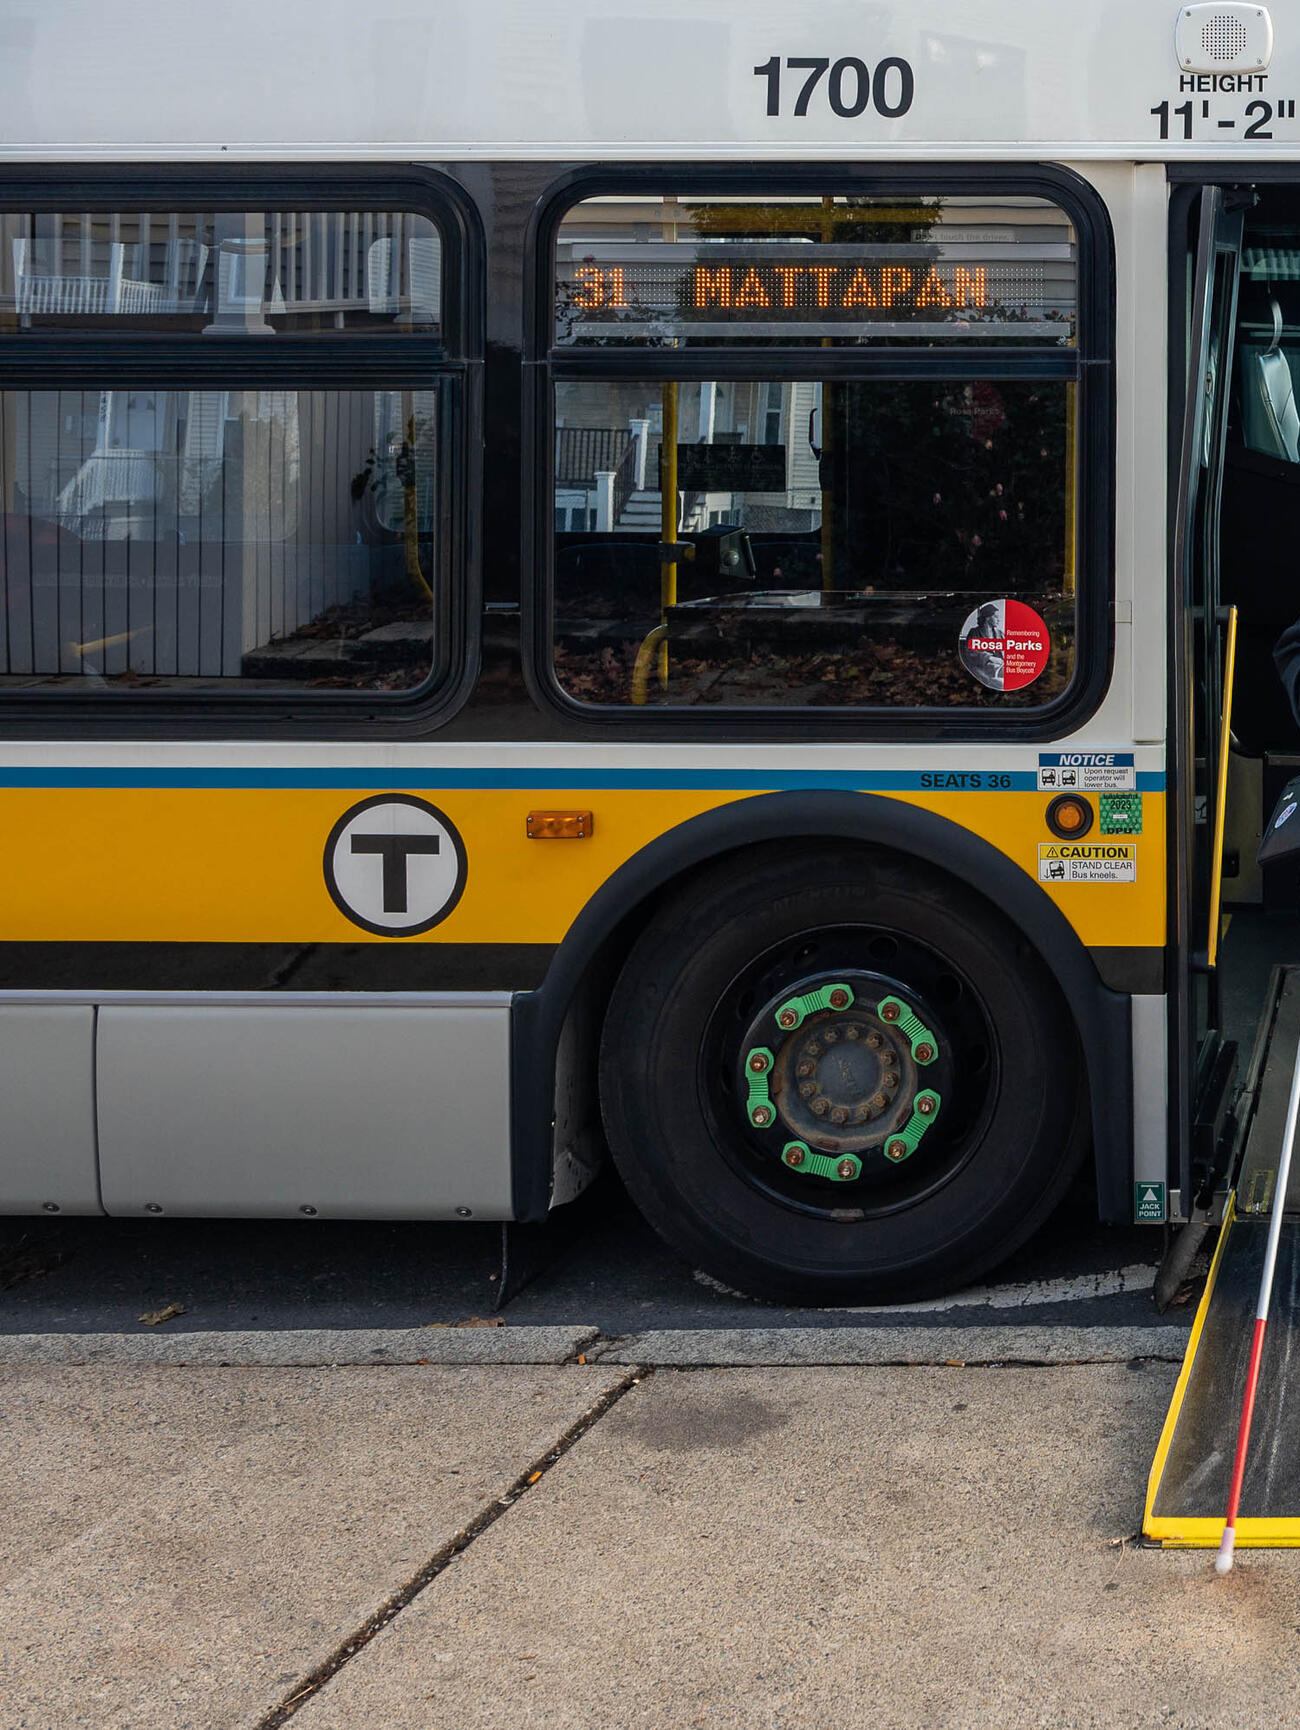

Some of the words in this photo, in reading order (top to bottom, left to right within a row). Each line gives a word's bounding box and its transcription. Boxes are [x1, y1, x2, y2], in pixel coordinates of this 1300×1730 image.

[754, 56, 914, 118] 1700
[1179, 74, 1269, 93] HEIGHT
[573, 267, 628, 308] 31
[695, 267, 986, 308] MATTAPAN
[1006, 629, 1040, 638] Remembering
[971, 639, 1003, 650] Rosa
[1006, 639, 1042, 651] Parks
[1059, 754, 1115, 766] NOTICE
[1084, 768, 1103, 776] Upon
[1103, 768, 1129, 776] request
[920, 773, 982, 788] SEATS
[987, 774, 1011, 789] 36
[1083, 775, 1112, 783] operator
[1110, 800, 1132, 810] 2023
[1060, 847, 1129, 858] CAUTION
[1072, 861, 1102, 870] STAND
[1103, 861, 1133, 870] CLEAR
[350, 833, 440, 913] T
[1072, 871, 1088, 879] Bus
[1089, 871, 1118, 879] kneels.
